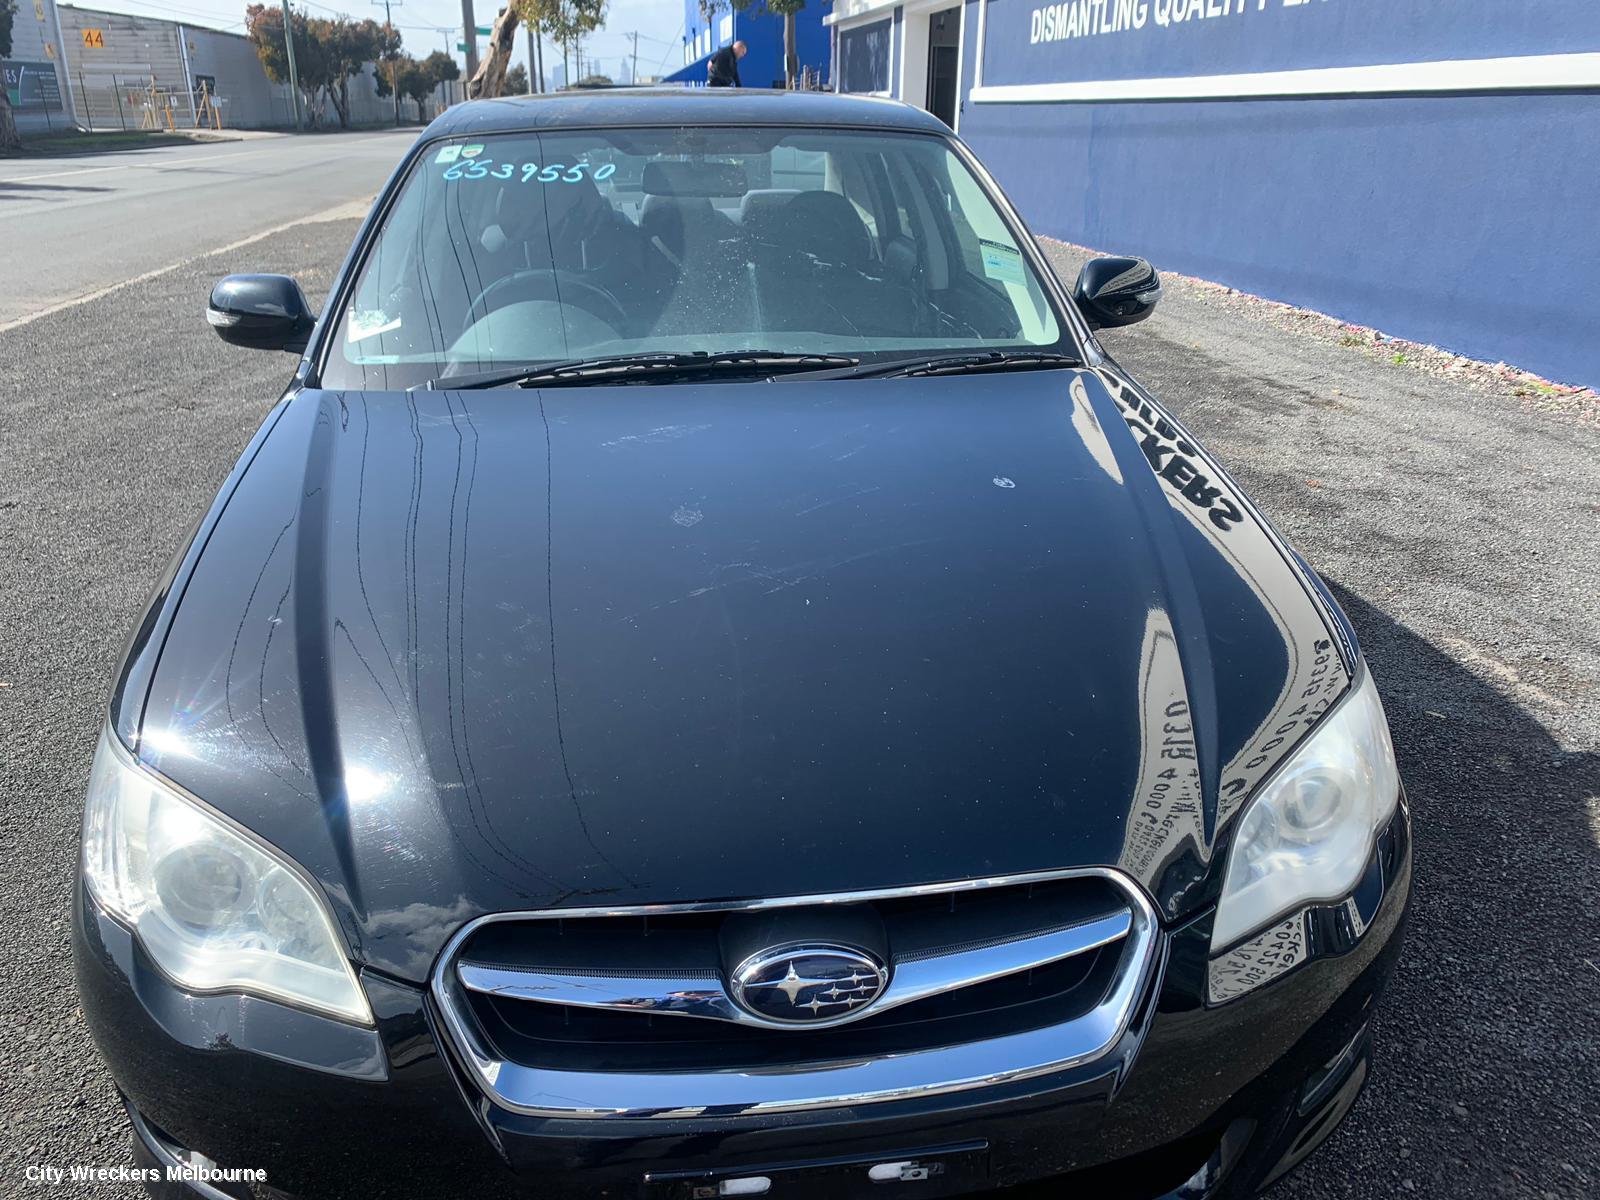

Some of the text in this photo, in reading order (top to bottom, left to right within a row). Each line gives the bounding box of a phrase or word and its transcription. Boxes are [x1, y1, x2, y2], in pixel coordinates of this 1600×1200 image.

[1030, 0, 1148, 44] DISMANTLING
[85, 31, 104, 48] 44
[443, 159, 616, 182] 6539550
